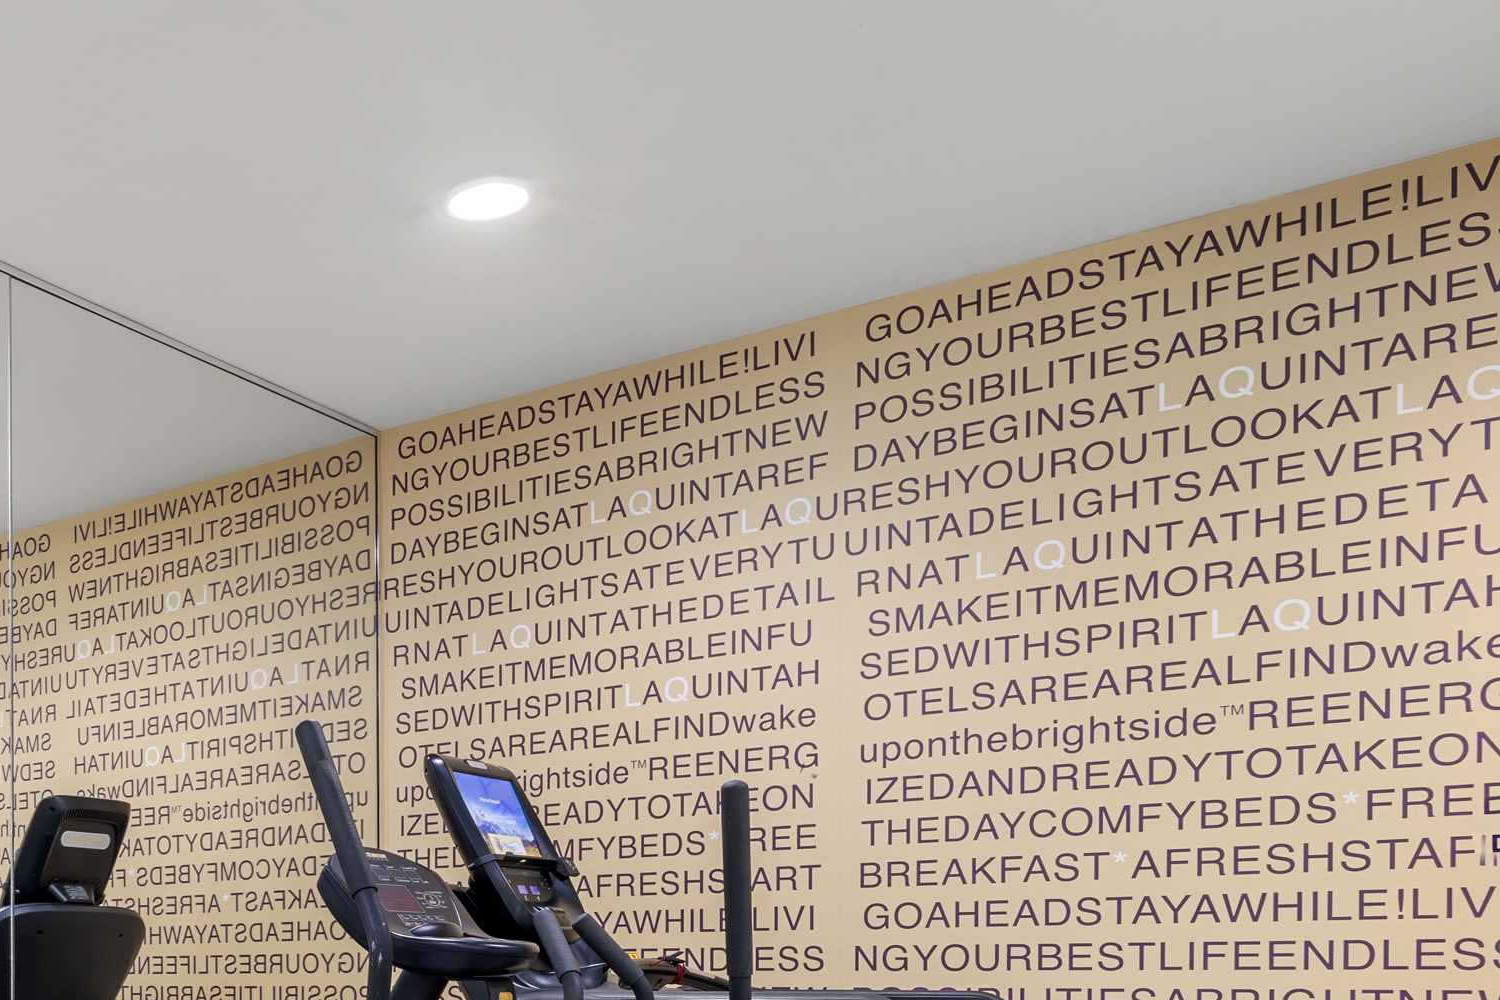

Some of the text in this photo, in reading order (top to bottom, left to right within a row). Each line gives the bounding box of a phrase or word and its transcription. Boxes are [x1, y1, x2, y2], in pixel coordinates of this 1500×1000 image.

[856, 211, 1500, 389] NGYOURBESTLIFEENDLES
[392, 370, 825, 497] NGYOURBESTLIFEENDLESS
[397, 330, 816, 460] GOAHEADSTAYAWHILE!LIVI
[390, 451, 829, 565] DAYBEGINSATLAQUINTAREF
[391, 409, 829, 531] POSSIBILITIESABRIGHTNEW
[393, 576, 836, 668] RNATLAQUINTATHEDETAIL
[401, 618, 812, 700] SMAKEITMEMORABLEINFU
[395, 658, 820, 735] SEDWITHSPIRITLAQUINTAH
[854, 937, 1500, 972] NGYOURBESTLIFEENDLES
